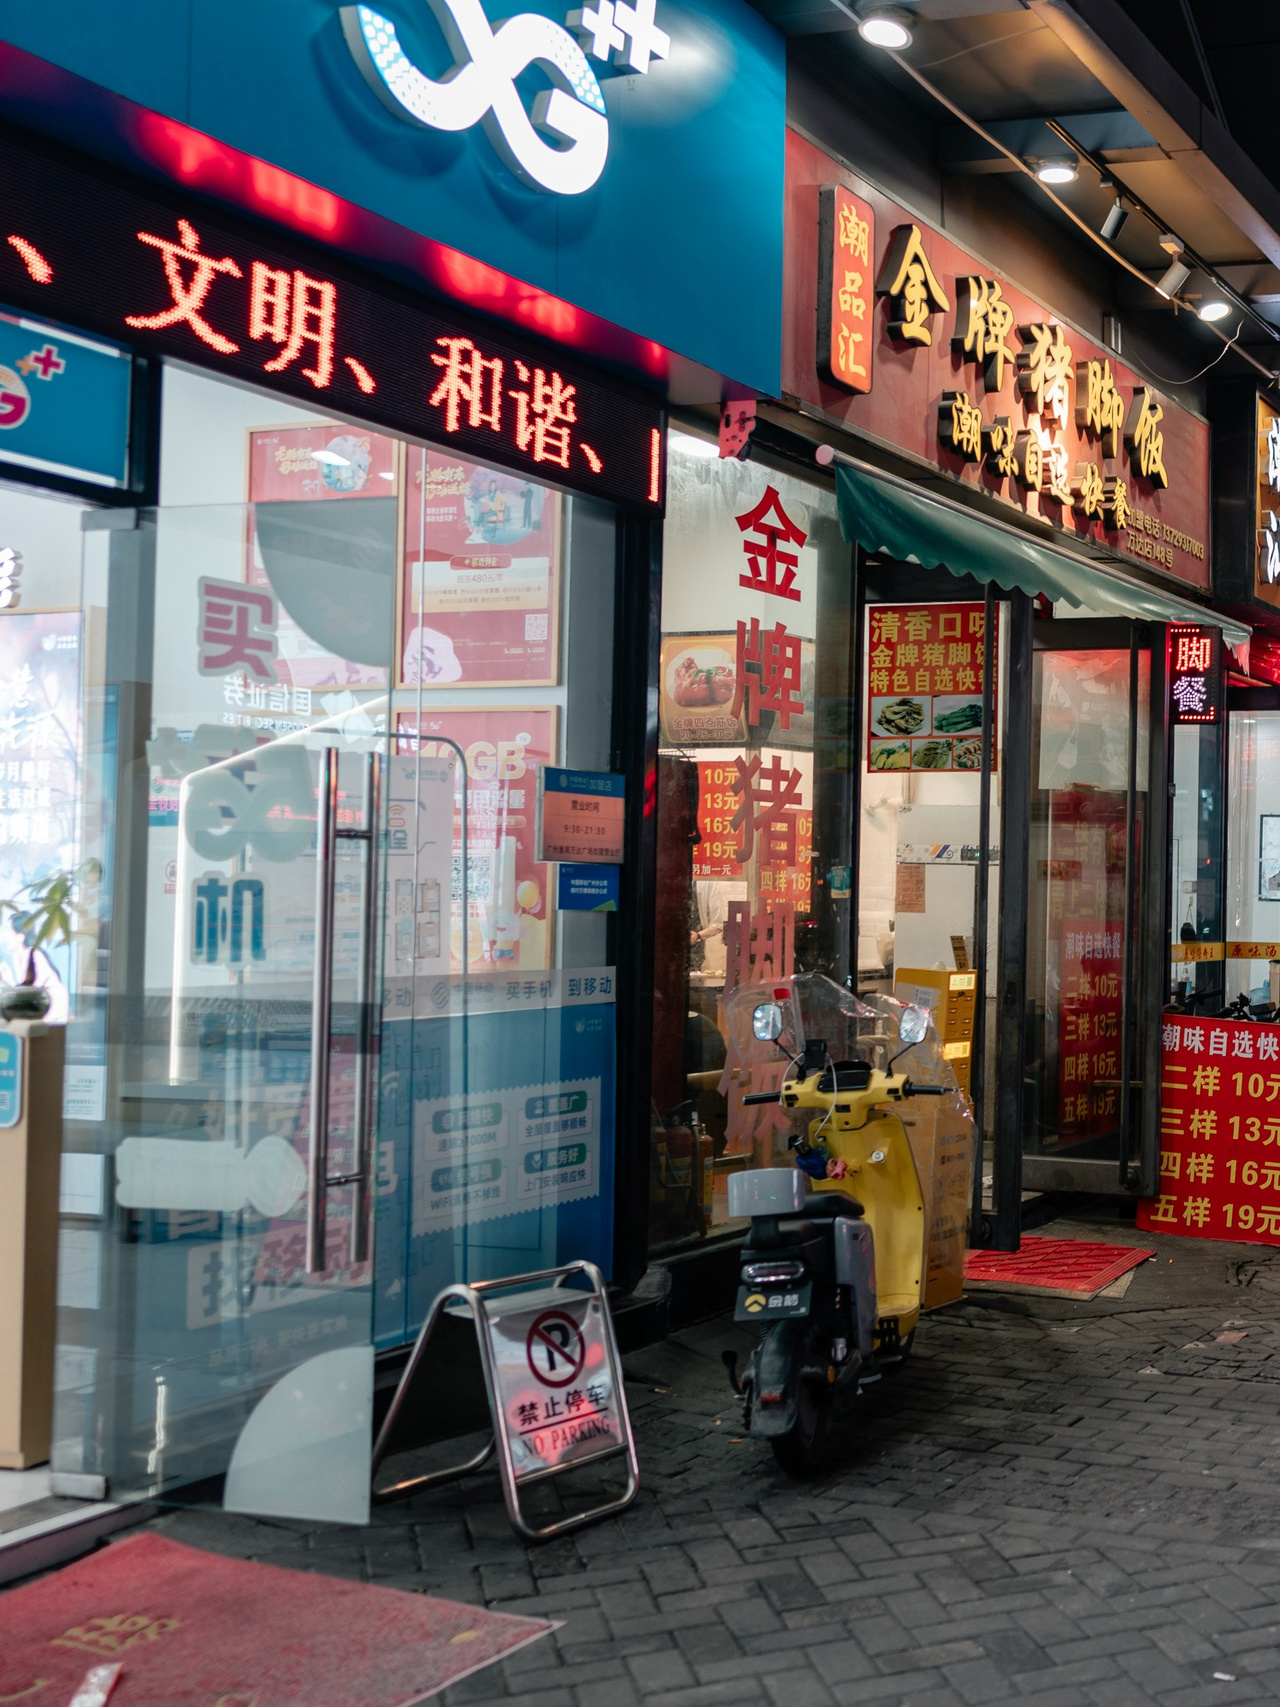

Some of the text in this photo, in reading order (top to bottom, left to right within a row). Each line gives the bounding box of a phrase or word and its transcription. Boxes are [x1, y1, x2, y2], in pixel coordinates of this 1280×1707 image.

[838, 203, 869, 378] 潮品汇
[890, 228, 1169, 489] 金牌猪脚饭
[952, 391, 1131, 529] 潮味自选快餐
[1127, 530, 1173, 568] 万达店148号
[871, 611, 997, 642] 清香口味
[871, 643, 997, 669] 金牌猪脚饭
[1176, 637, 1211, 671] 脚
[1173, 676, 1207, 713] 餐
[705, 768, 740, 786] 10元
[571, 800, 600, 813] 营业时间
[705, 793, 740, 810] 13元
[564, 824, 606, 836] 9:30-21:30
[704, 842, 738, 859] 19元
[761, 871, 787, 891] 四样
[1065, 932, 1121, 960] 潮味自选快餐
[506, 980, 553, 1001] 买手机
[568, 976, 612, 996] 到移动
[1095, 975, 1118, 998] 10元
[1065, 1013, 1117, 1041] 三样 13元
[1065, 1054, 1088, 1082] 四样
[1162, 1065, 1221, 1096] 二样
[1064, 1095, 1088, 1123] 五样
[1161, 1107, 1217, 1140] 三样
[547, 1148, 579, 1166] 服务好
[1160, 1151, 1214, 1184] 四样
[1151, 1195, 1211, 1228] 五样
[518, 1384, 605, 1426] 禁止停车
[551, 1415, 610, 1451] PARKING
